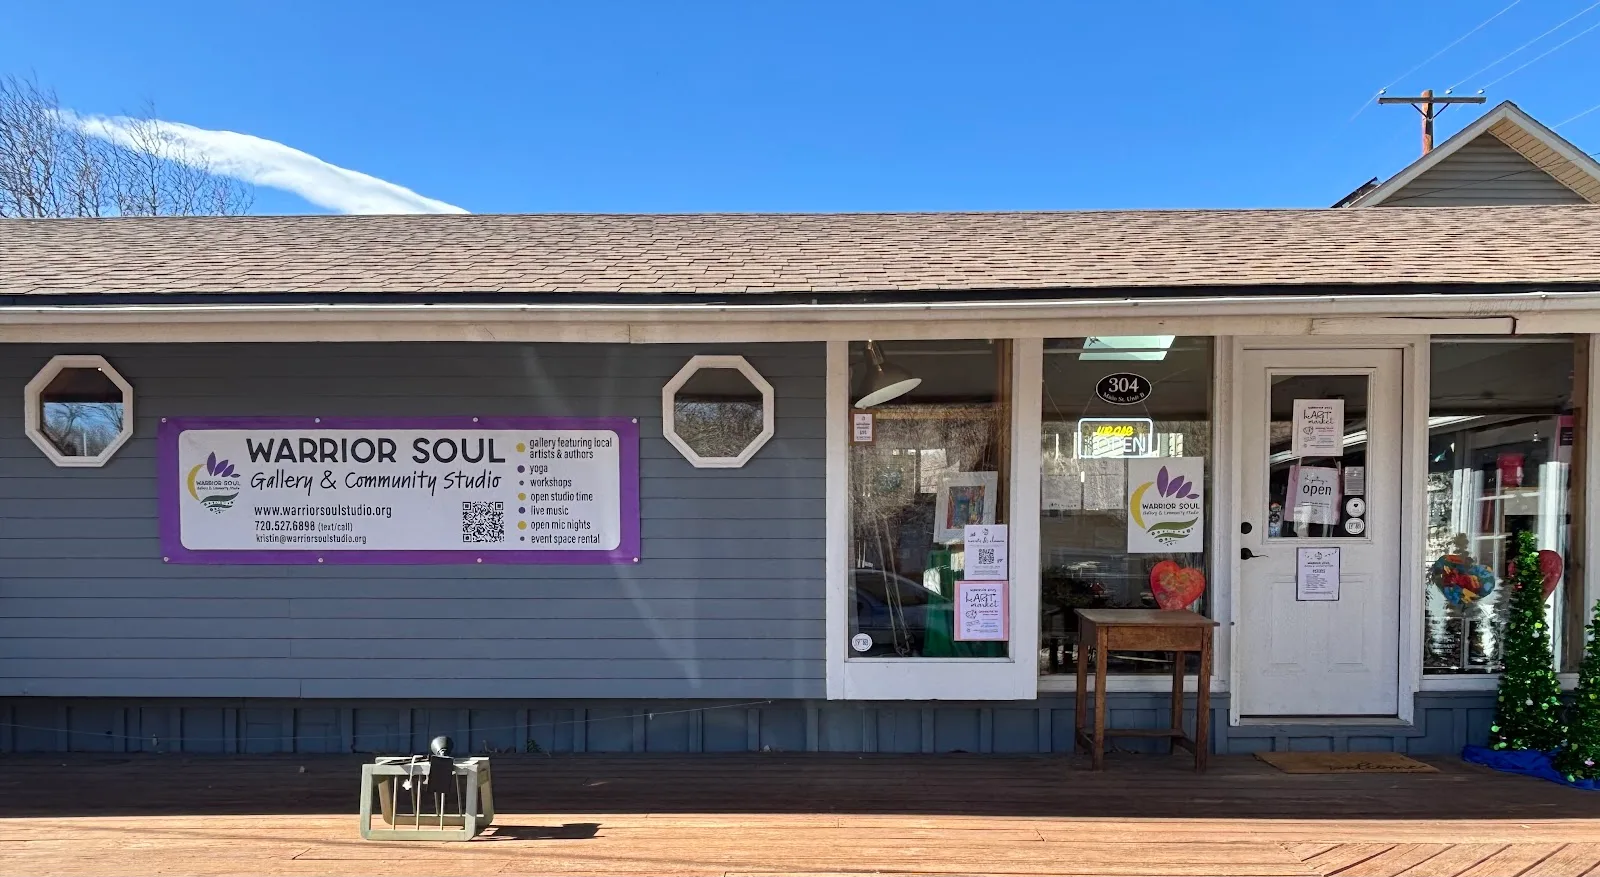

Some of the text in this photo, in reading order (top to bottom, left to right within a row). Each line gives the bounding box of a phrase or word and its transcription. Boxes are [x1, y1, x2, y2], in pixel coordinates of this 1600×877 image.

[1108, 377, 1139, 393] 304
[529, 437, 612, 450] gallery featuring local
[246, 437, 506, 464] WARRIOR SOUL
[529, 449, 594, 459] artists & authors
[529, 465, 548, 475] yoga
[250, 468, 502, 497] Gallery & Community Studio
[530, 477, 572, 488] workshops
[1302, 484, 1332, 497] open
[530, 491, 593, 503] open studio time
[254, 504, 392, 518] www.warriorsoulstudio.org
[530, 505, 569, 515] live music
[1179, 502, 1200, 510] SOUL
[254, 520, 353, 533] 720.527.6898 (text/call)
[530, 519, 591, 531] open mic nights
[255, 534, 367, 545] kristin@warriorsoulstudio.org
[531, 533, 600, 545] event space rental
